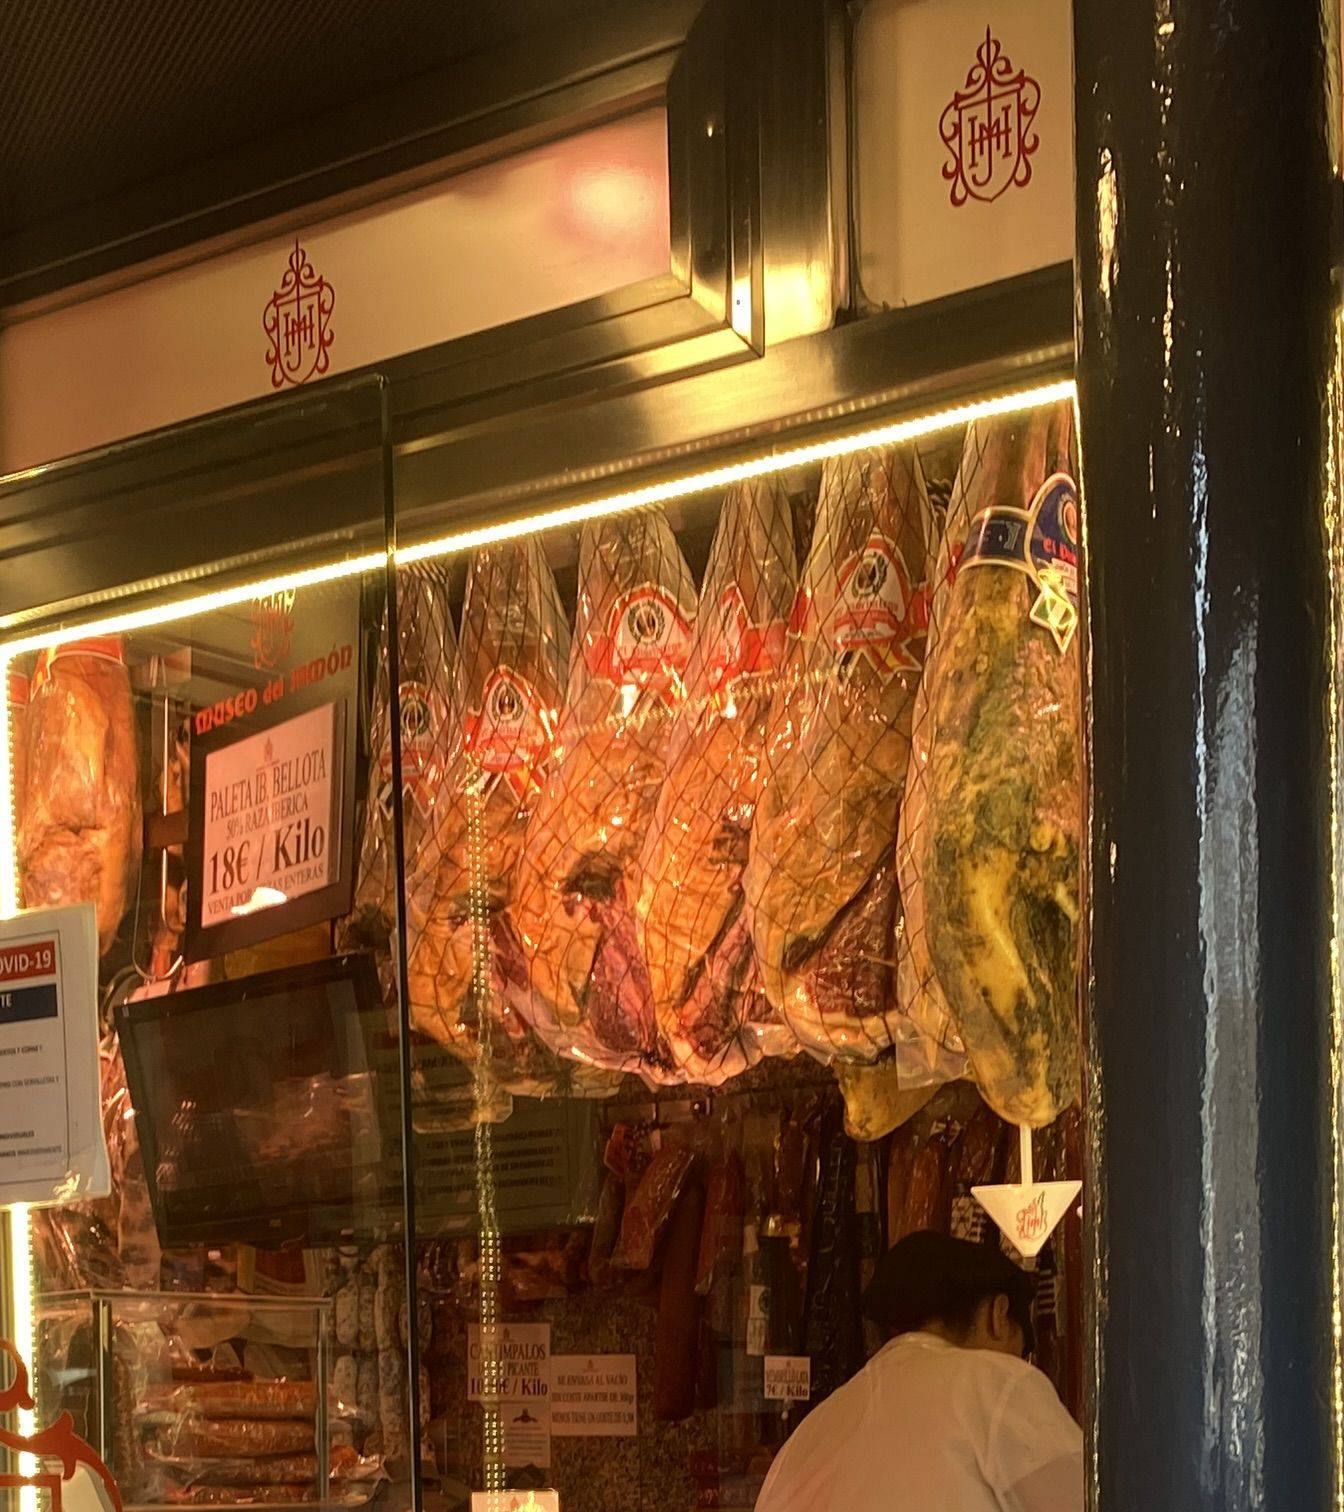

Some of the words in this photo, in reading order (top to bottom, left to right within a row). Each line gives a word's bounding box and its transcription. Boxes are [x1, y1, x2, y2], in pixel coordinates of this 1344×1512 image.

[211, 778, 252, 823] PALETA
[256, 771, 270, 806] IB.
[273, 748, 326, 798] BELLOTA
[210, 841, 251, 895] 18€
[256, 834, 266, 881] /
[272, 818, 325, 874] Kilo
[470, 1343, 547, 1361] CIMPALOS
[521, 1377, 548, 1397] Kilo
